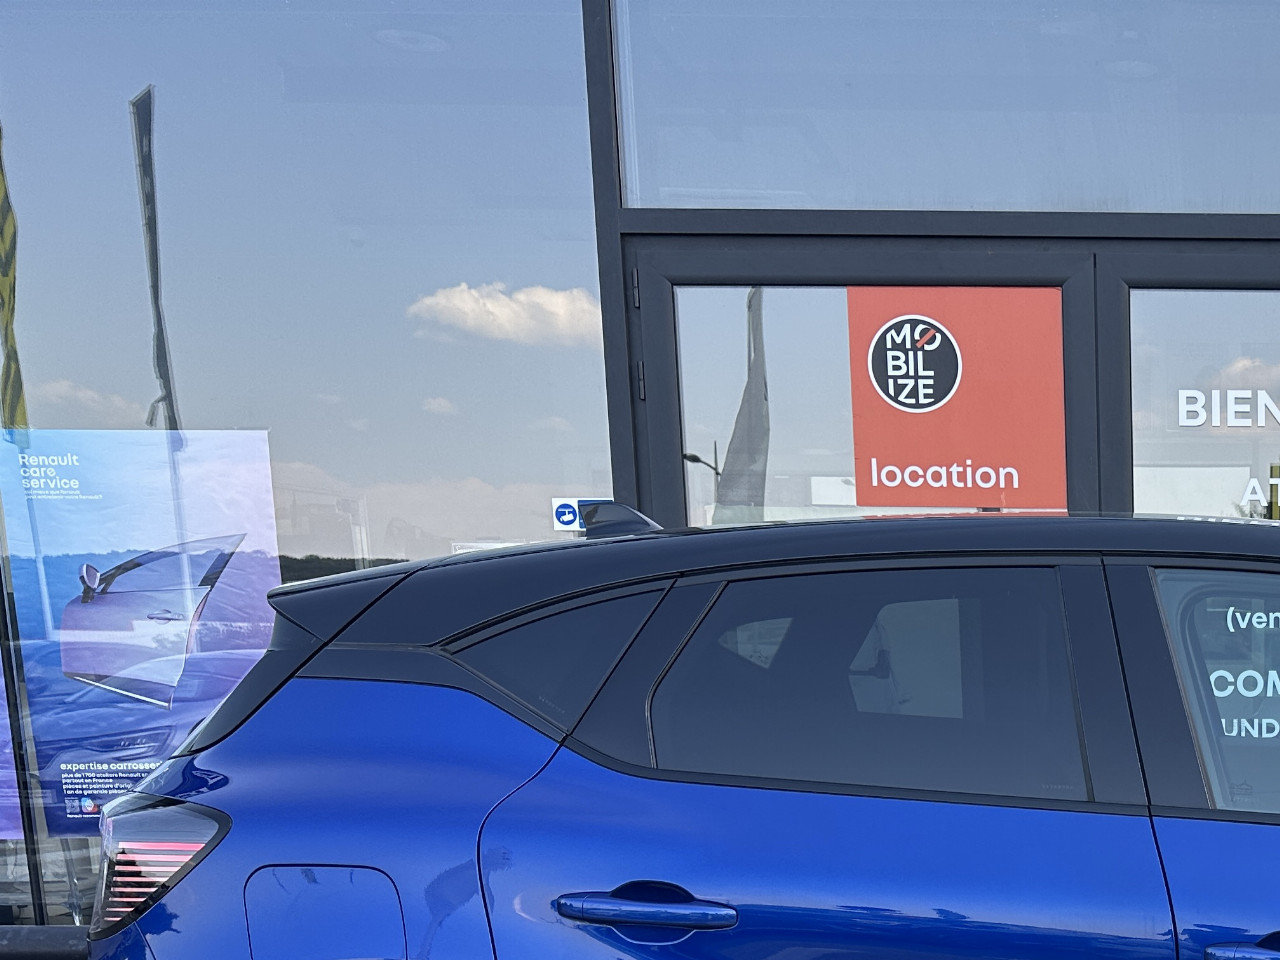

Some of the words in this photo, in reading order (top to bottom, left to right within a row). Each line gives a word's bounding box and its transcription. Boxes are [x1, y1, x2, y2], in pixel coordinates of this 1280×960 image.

[18, 453, 79, 466] Renault
[20, 467, 56, 477] care
[871, 457, 1019, 489] location
[22, 476, 79, 488] service
[60, 762, 108, 772] expertise
[110, 761, 162, 770] carrosser
